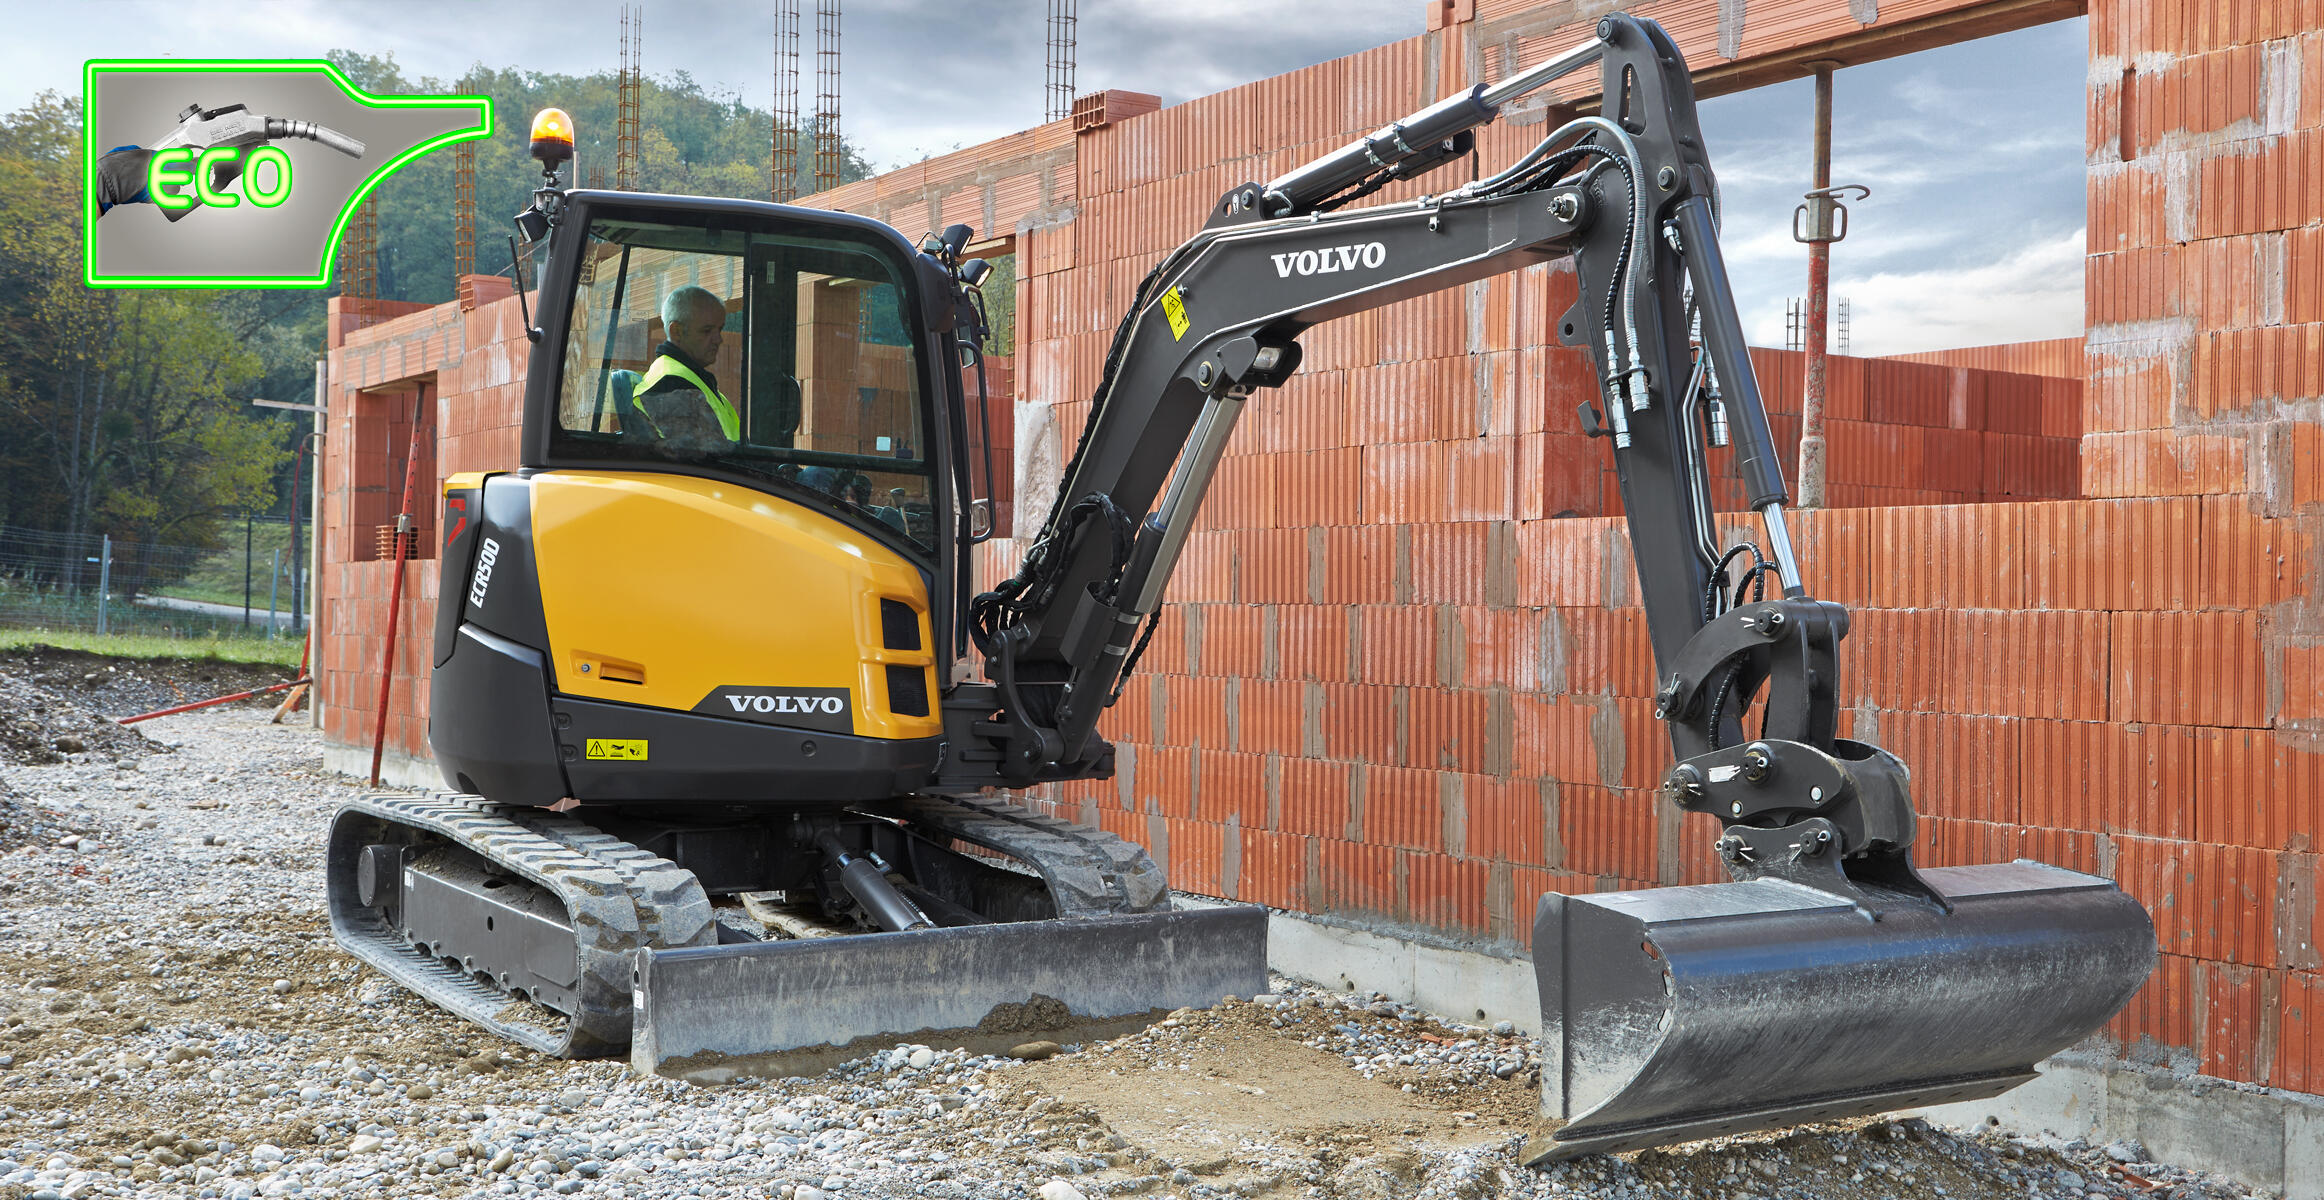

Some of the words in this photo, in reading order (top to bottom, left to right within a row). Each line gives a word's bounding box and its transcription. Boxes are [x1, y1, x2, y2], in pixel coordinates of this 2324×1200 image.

[1270, 241, 1386, 278] VOLVO
[470, 537, 500, 609] ECR50D
[725, 695, 844, 714] VOLVO
